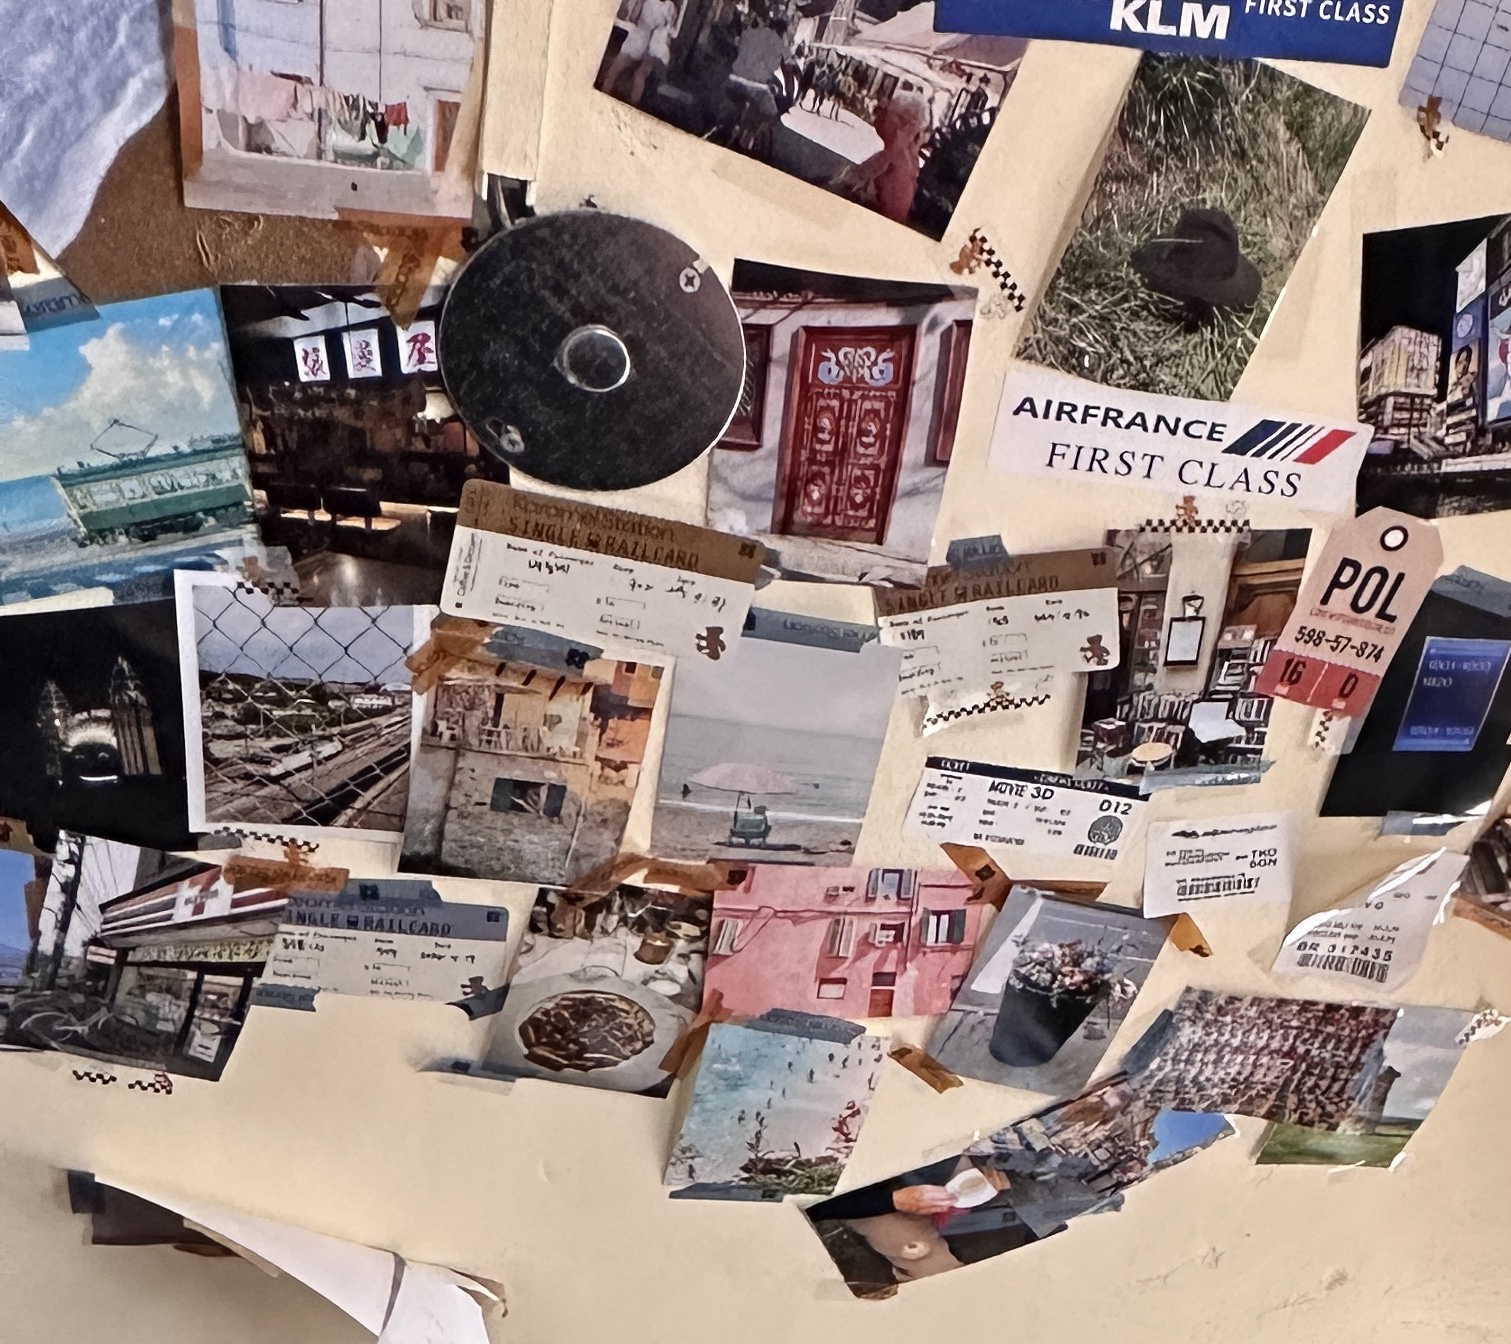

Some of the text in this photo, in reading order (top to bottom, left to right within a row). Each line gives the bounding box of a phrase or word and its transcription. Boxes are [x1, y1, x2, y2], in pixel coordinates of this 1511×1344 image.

[1110, 0, 1391, 39] KLM FIRST CLASS
[1012, 396, 1228, 443] AIRFRANCE
[1045, 441, 1303, 499] FIRST CLASS
[1319, 556, 1406, 623] POL
